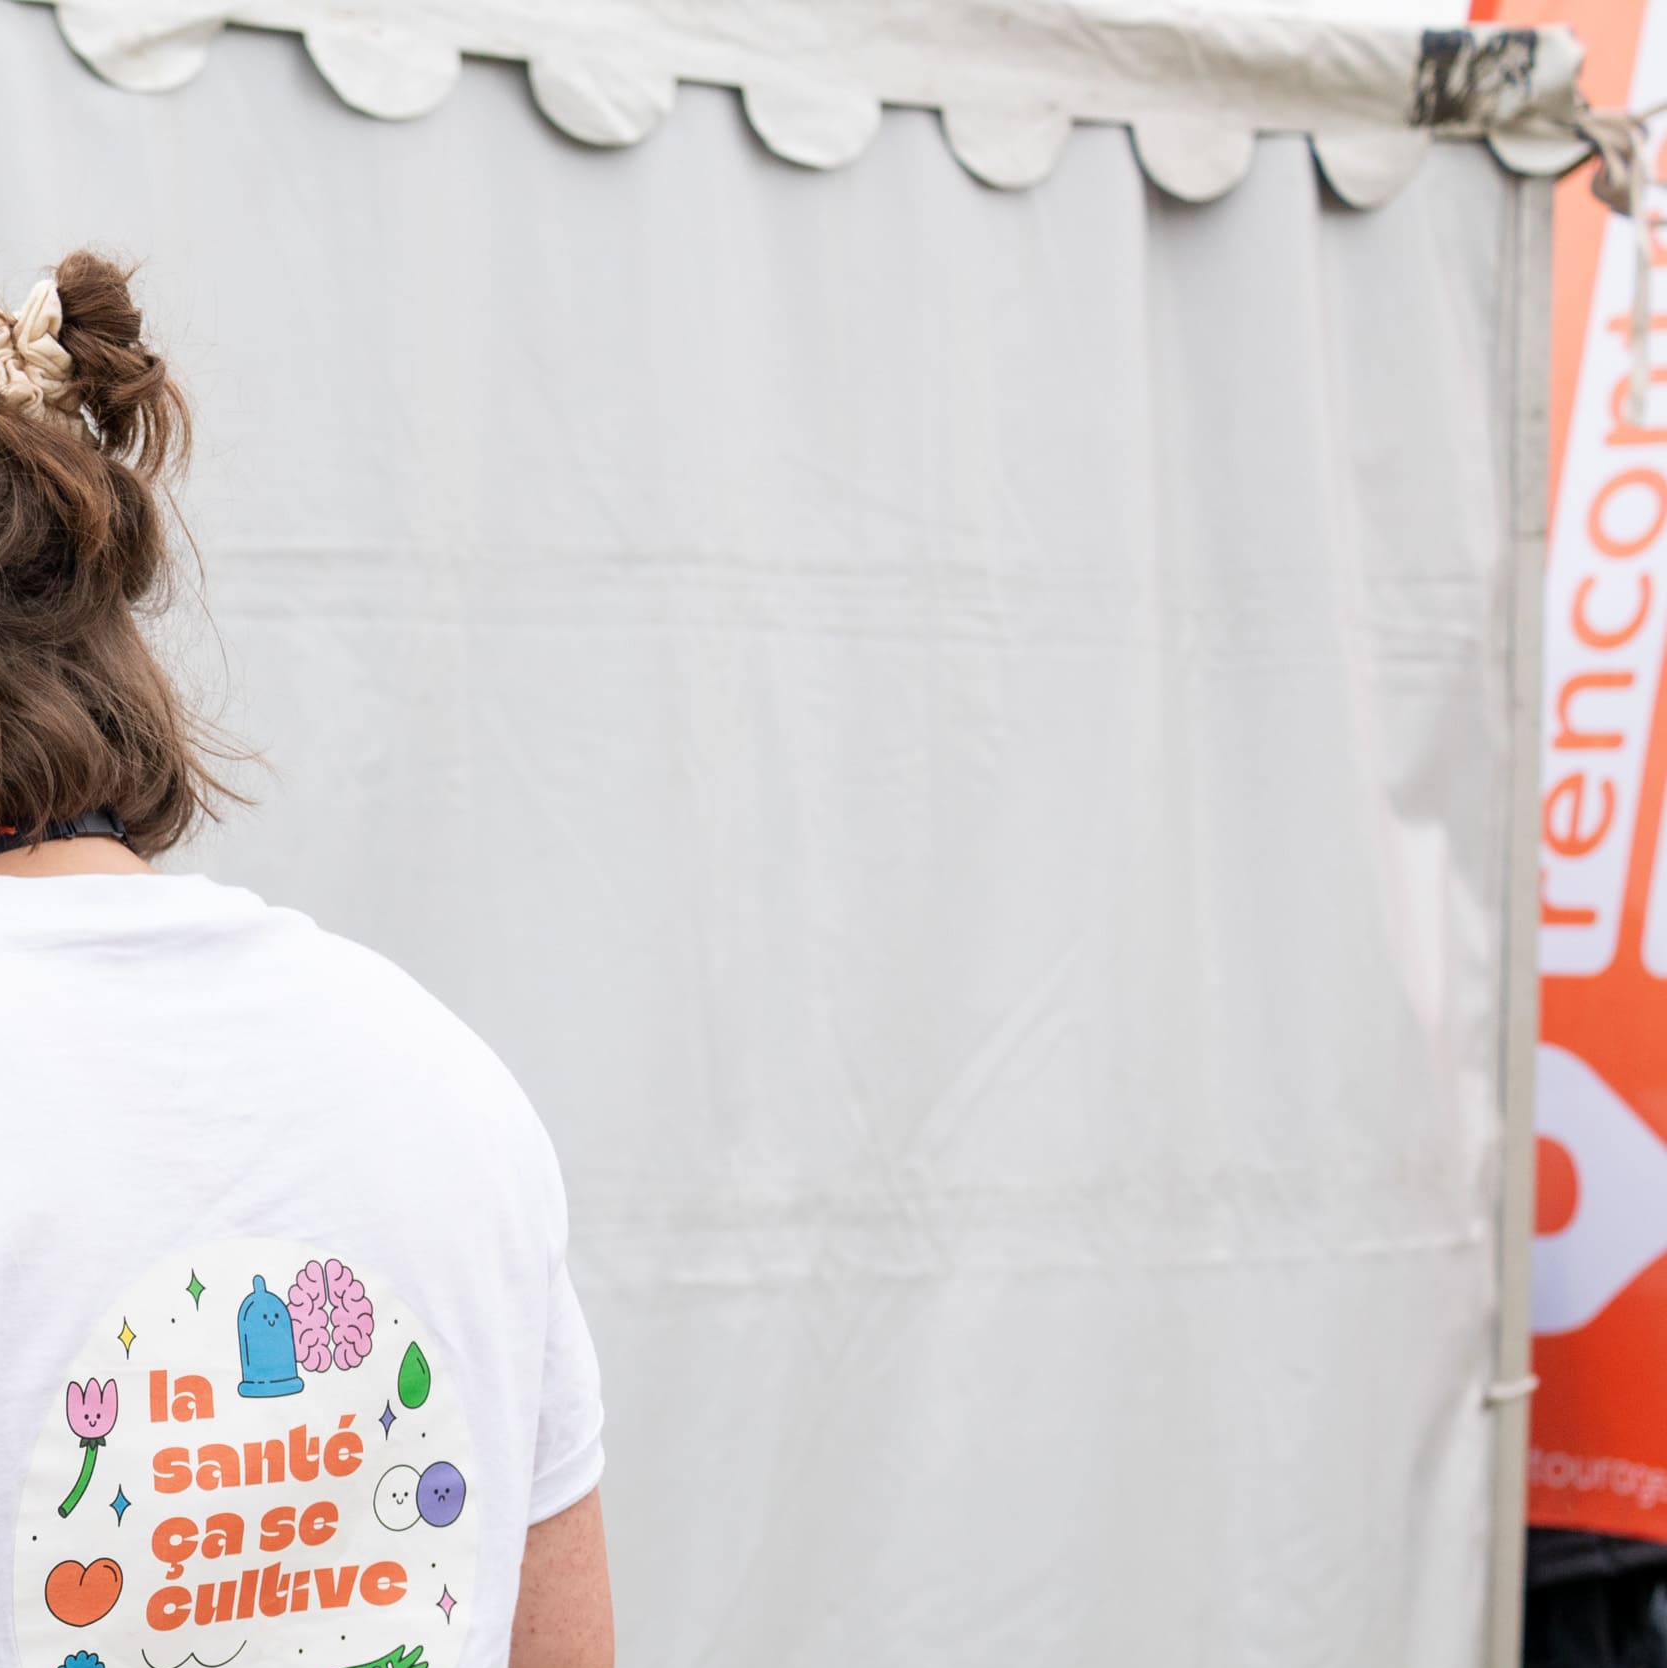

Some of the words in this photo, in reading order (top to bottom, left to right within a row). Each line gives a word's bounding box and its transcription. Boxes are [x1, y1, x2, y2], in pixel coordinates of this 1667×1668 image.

[148, 1368, 216, 1424] la
[150, 1412, 365, 1496] santé
[150, 1510, 246, 1581] ça
[258, 1499, 340, 1553] se
[144, 1559, 409, 1633] cultive
